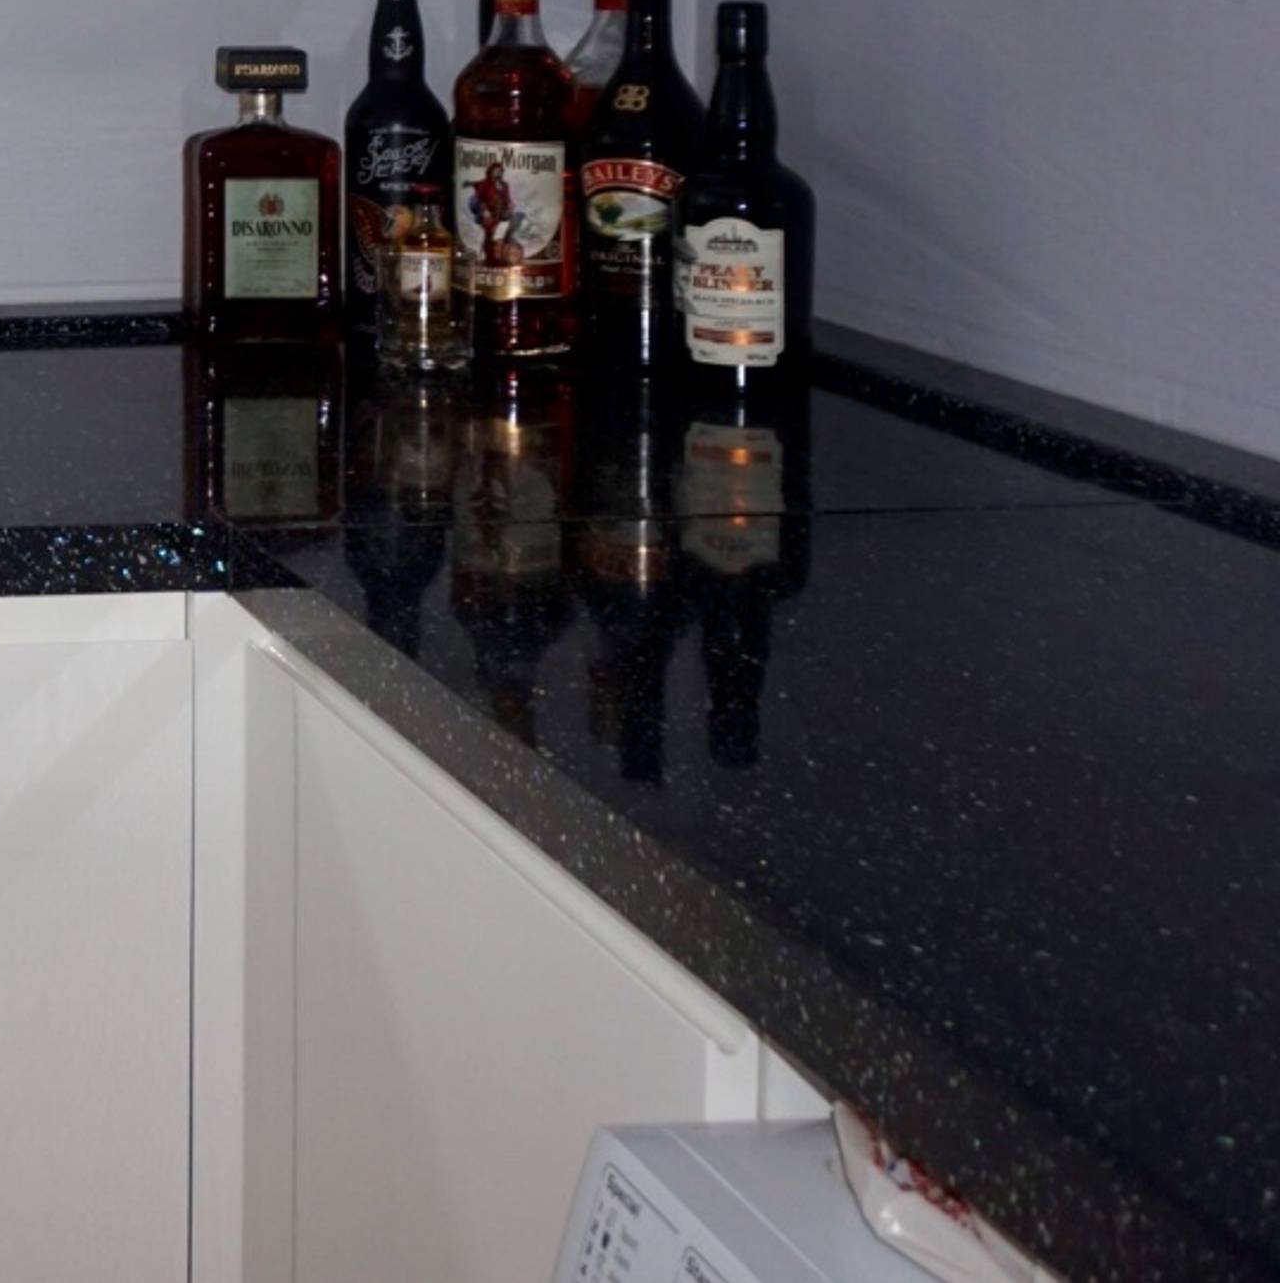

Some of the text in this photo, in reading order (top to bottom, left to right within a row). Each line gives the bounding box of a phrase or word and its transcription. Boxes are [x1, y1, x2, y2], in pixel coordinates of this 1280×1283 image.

[234, 63, 301, 76] DISARONNO
[498, 147, 557, 174] Morgan
[583, 163, 675, 191] BAILEYS
[231, 220, 313, 238] DISARONNO
[592, 250, 666, 266] ORIGINL
[698, 263, 765, 278] PEAY
